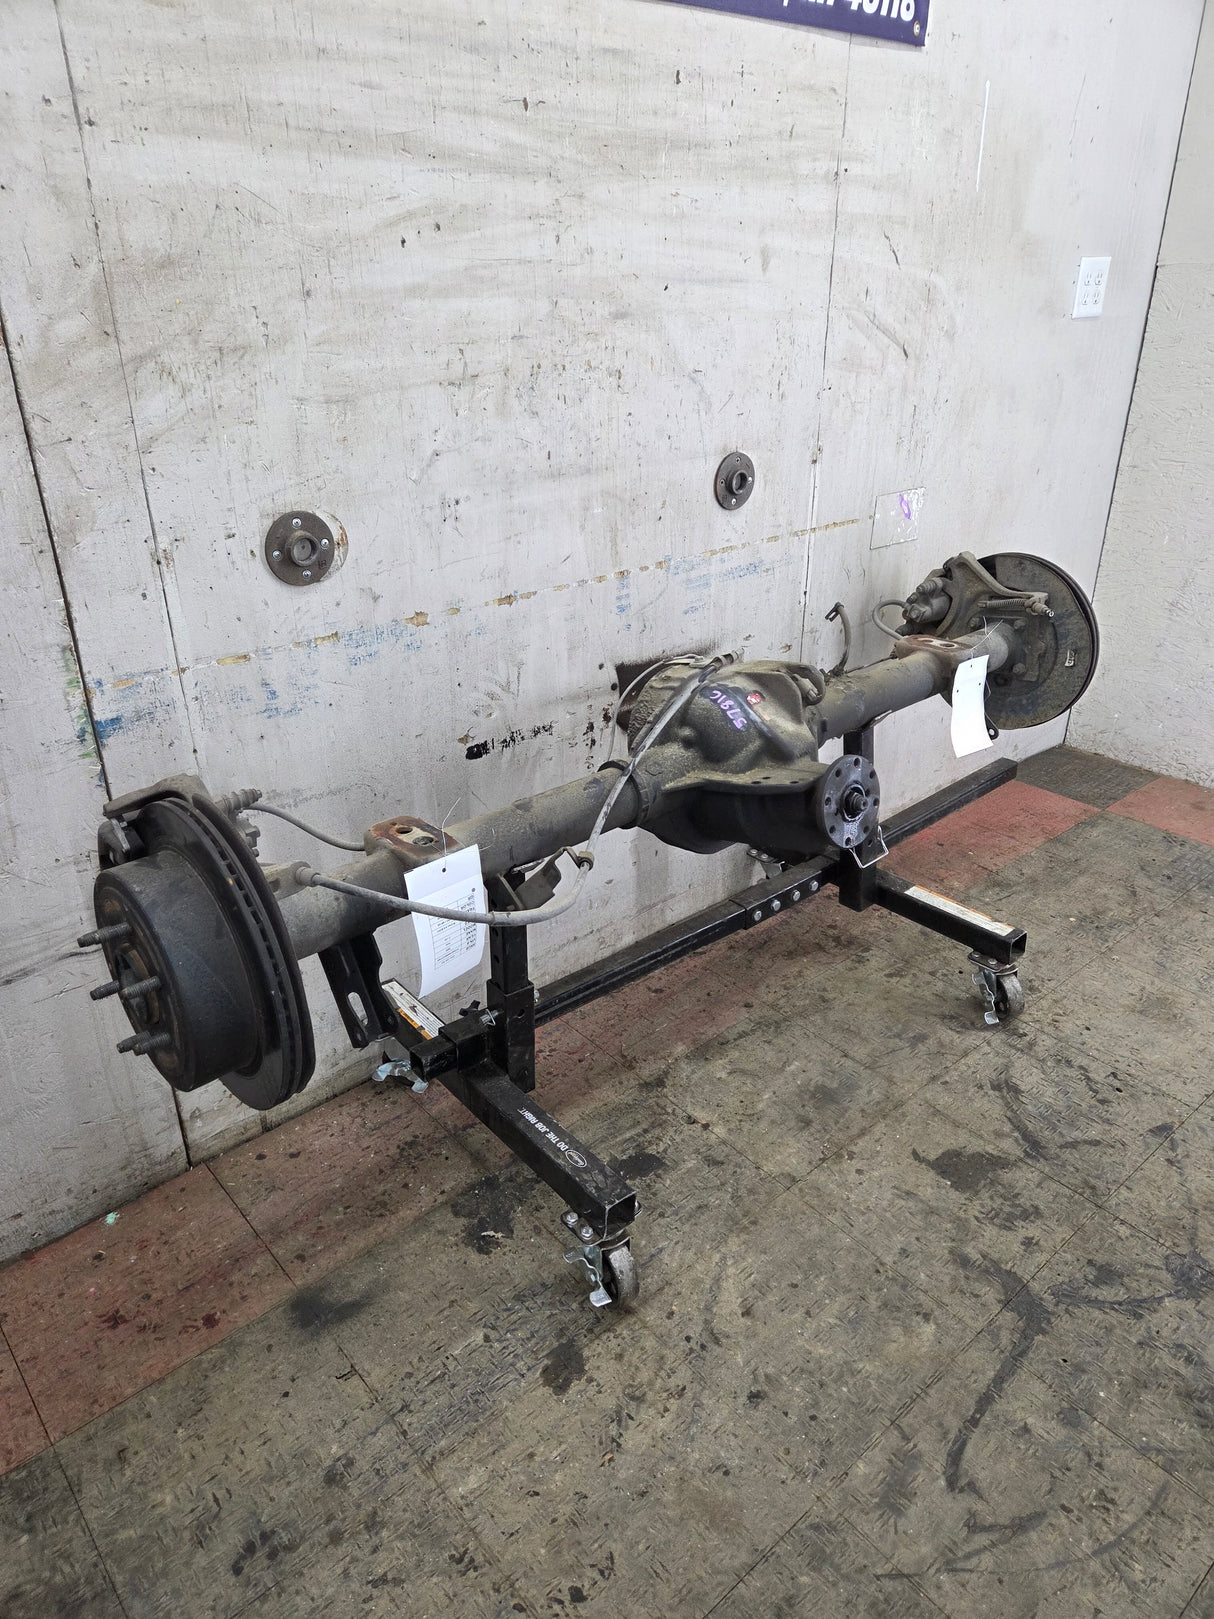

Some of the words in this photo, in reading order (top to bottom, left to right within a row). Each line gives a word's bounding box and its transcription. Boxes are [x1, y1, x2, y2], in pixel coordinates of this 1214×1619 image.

[534, 1121, 550, 1133] JOB
[545, 1131, 560, 1143] THE
[556, 1141, 569, 1151] DO
